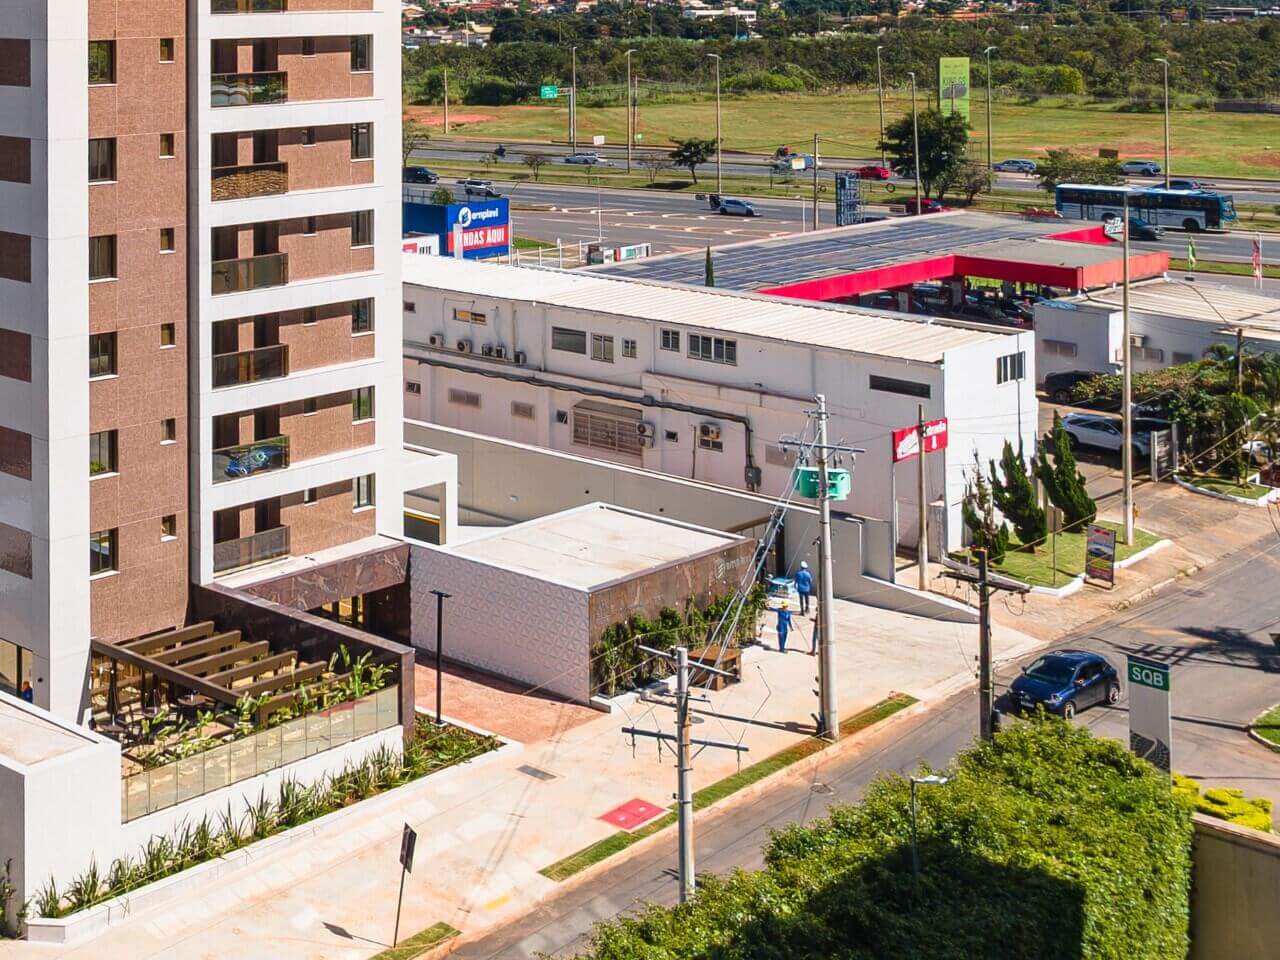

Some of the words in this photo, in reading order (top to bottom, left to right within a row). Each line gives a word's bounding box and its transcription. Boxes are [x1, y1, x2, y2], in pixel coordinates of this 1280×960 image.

[462, 230, 485, 246] NDAS
[487, 228, 505, 243] AQUI
[1132, 667, 1163, 686] SQB
